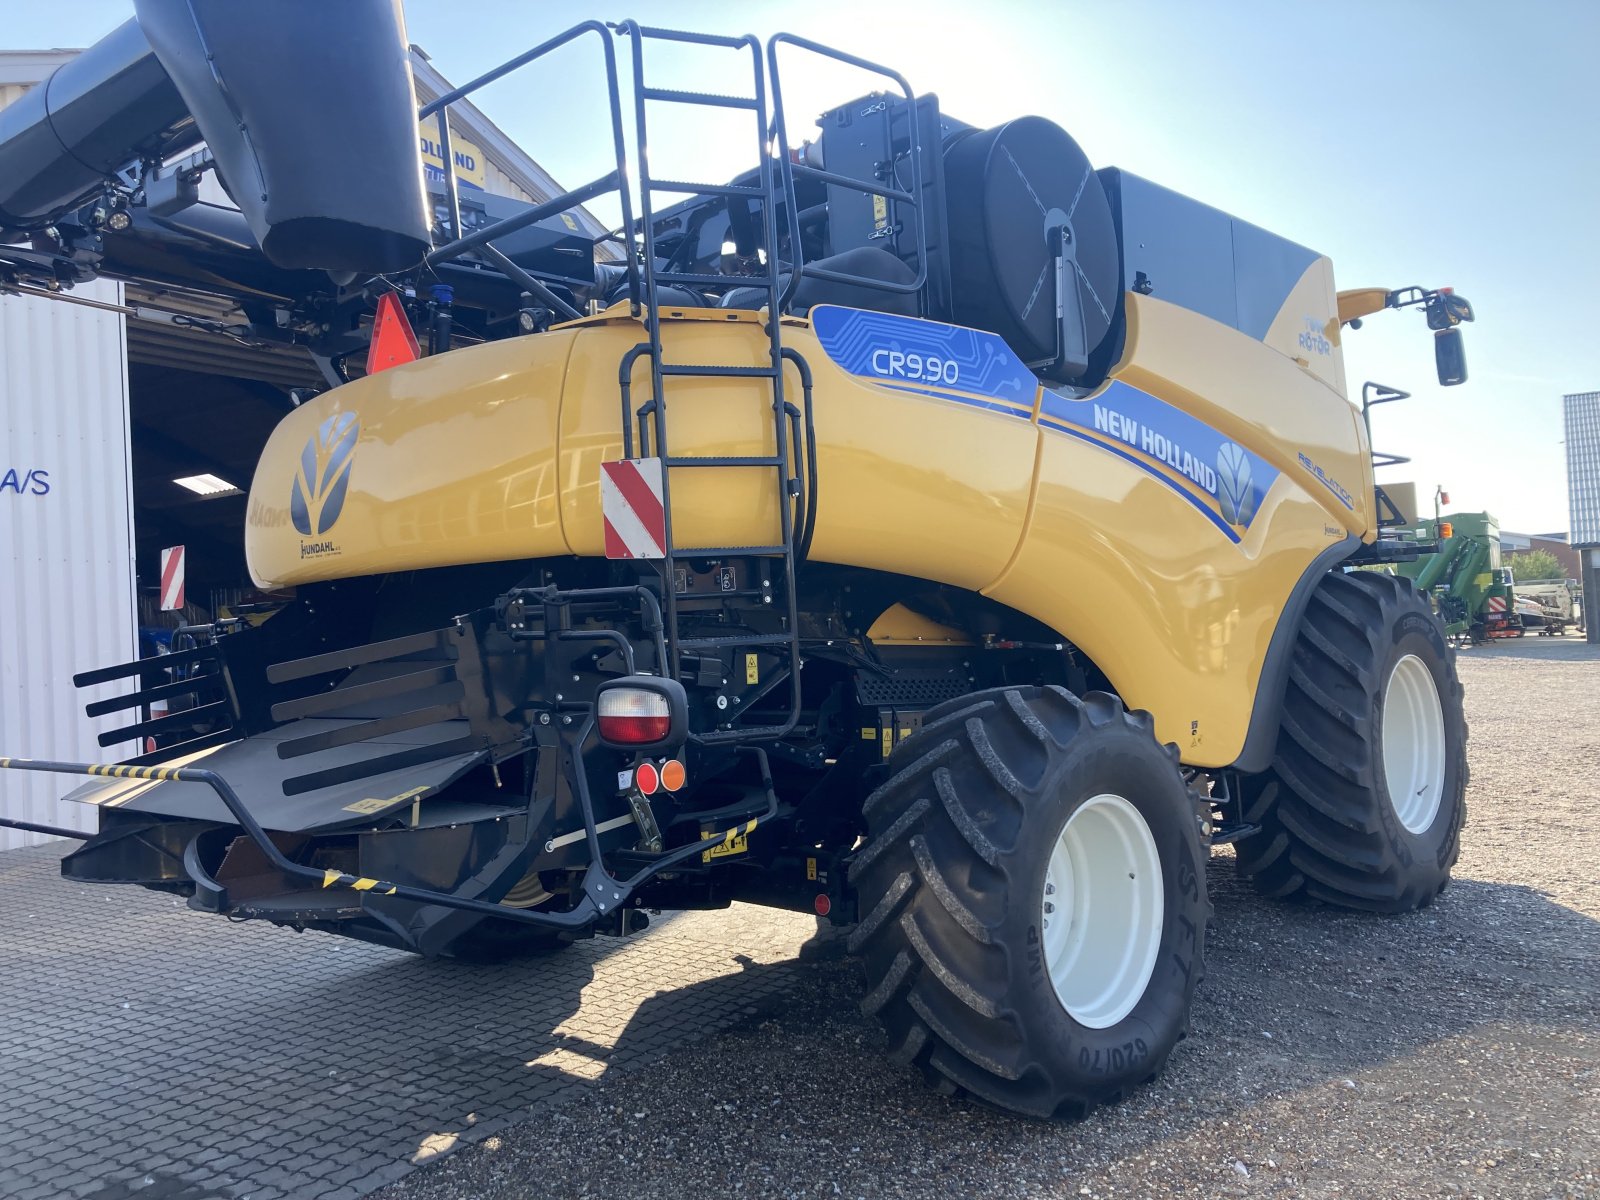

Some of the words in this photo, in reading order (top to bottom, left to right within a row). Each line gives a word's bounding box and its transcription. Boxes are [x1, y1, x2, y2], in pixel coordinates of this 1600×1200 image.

[420, 137, 475, 172] OLLND
[872, 349, 959, 385] CR9.90
[1094, 403, 1138, 446] NEW
[1141, 425, 1217, 495] HOLLAND
[0, 468, 50, 496] A/S
[1078, 1037, 1149, 1076] 620/70
